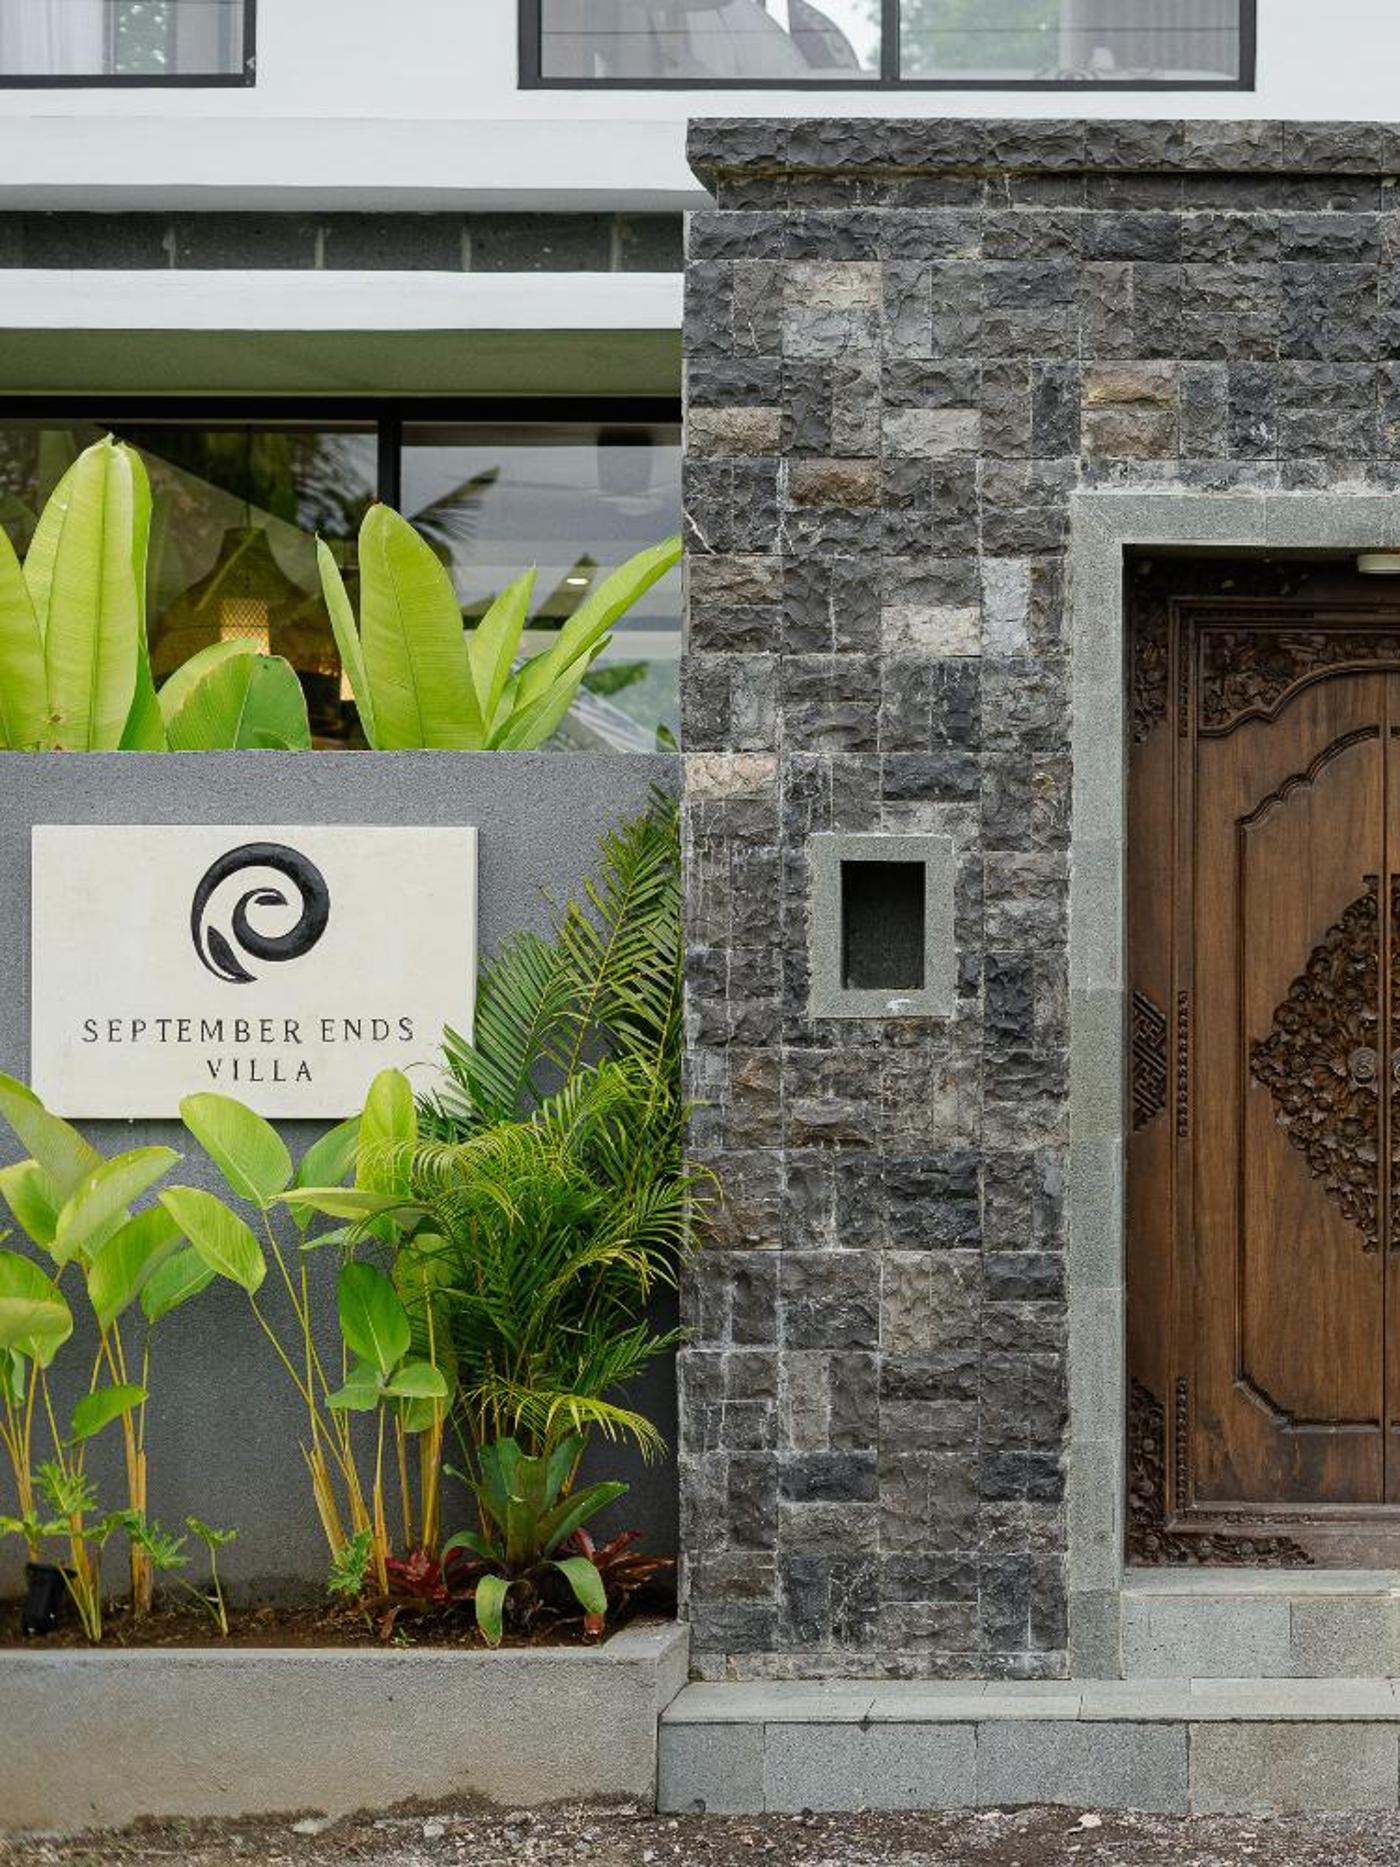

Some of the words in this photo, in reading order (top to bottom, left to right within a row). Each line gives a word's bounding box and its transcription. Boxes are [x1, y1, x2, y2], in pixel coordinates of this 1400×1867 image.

[82, 1018, 302, 1044] SEPTEMBER
[320, 1016, 415, 1043] ENDS
[206, 1058, 313, 1082] VILLA
